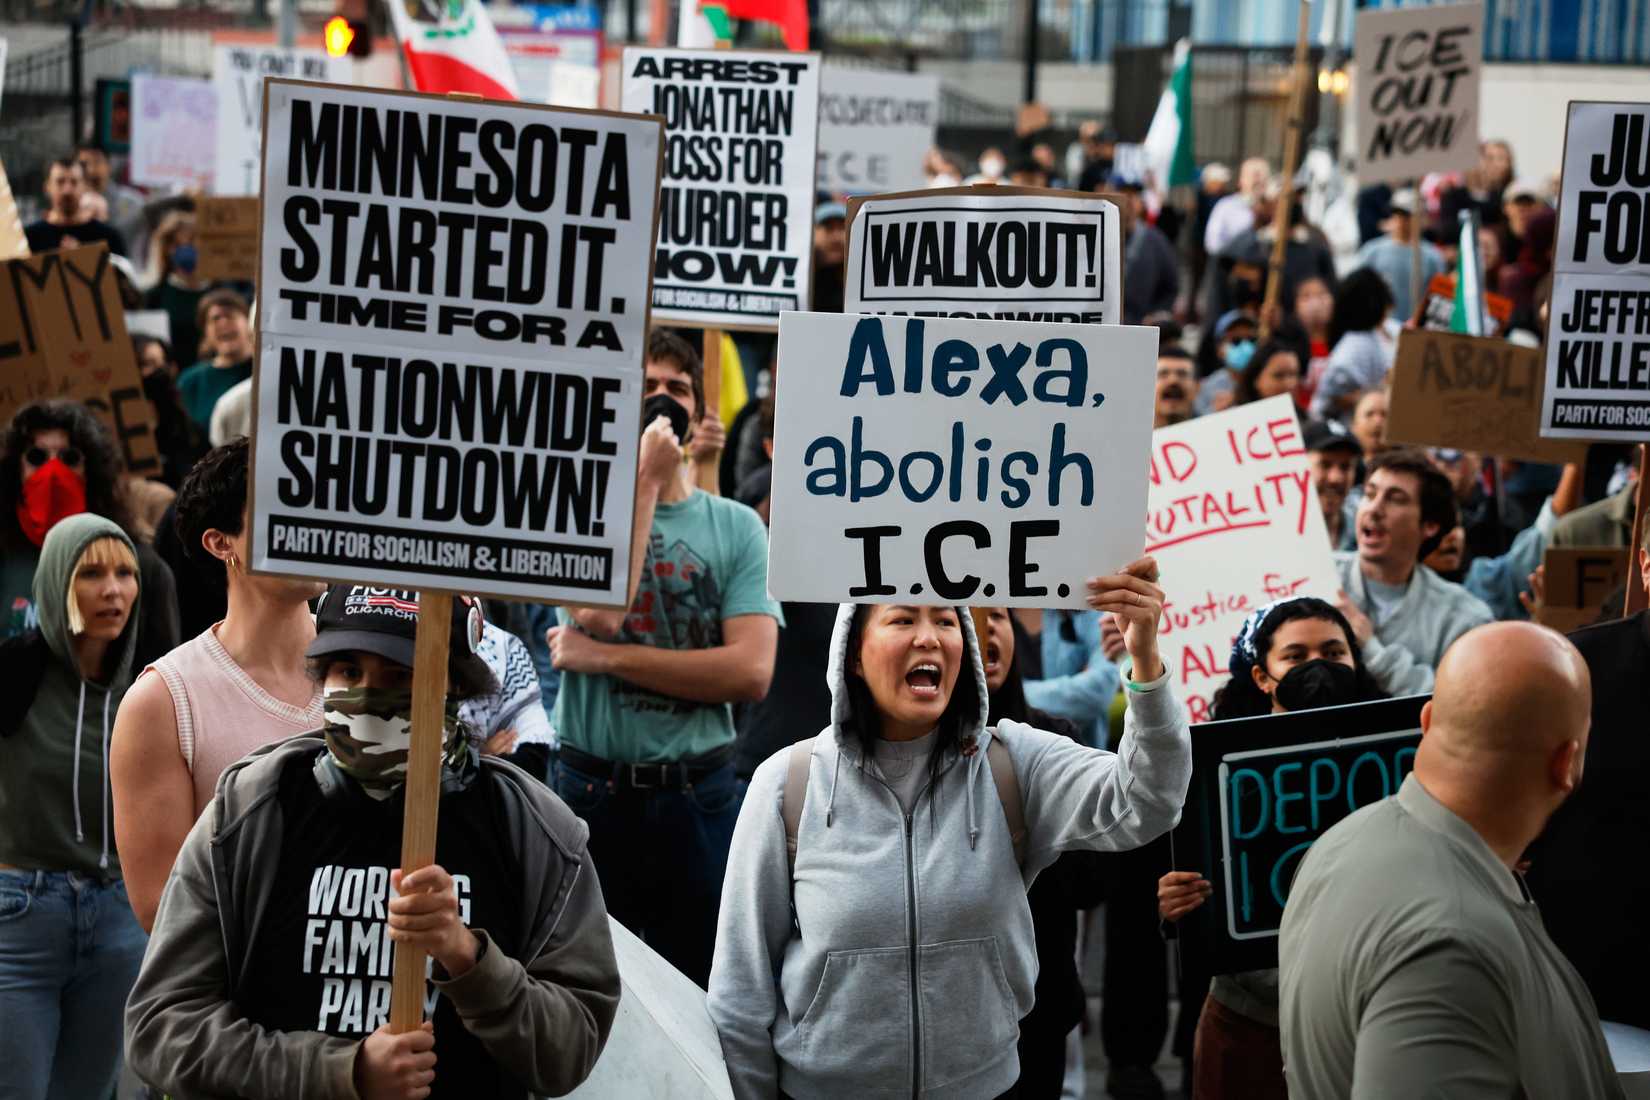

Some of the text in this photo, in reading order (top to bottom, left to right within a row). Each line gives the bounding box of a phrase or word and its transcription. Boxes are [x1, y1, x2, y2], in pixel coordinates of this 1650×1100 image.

[632, 57, 808, 85] ARREST
[1374, 26, 1471, 75] ICE
[643, 84, 793, 136] JONATHAN
[1370, 67, 1470, 118] OUT
[287, 99, 632, 222] MINNESOTA
[728, 138, 784, 186] FOR
[1366, 109, 1467, 163] NOW
[280, 195, 549, 306] STARTED
[557, 223, 625, 315] IT.
[870, 220, 1098, 289] WALKOUT!
[279, 288, 624, 352] TIME FOR A
[840, 317, 1105, 408] Alexa,
[277, 346, 622, 456] NATIONWIDE
[1556, 404, 1597, 426] PARTY
[1599, 405, 1625, 425] FOR
[803, 416, 1095, 508] abolish
[1227, 418, 1307, 465] ICE
[277, 430, 612, 538] SHUTDOWN!
[272, 524, 606, 582] PARTY FOR SOCIALISM & LIBERATION
[844, 519, 1070, 600] I.C.E.
[1158, 591, 1253, 634] Justice
